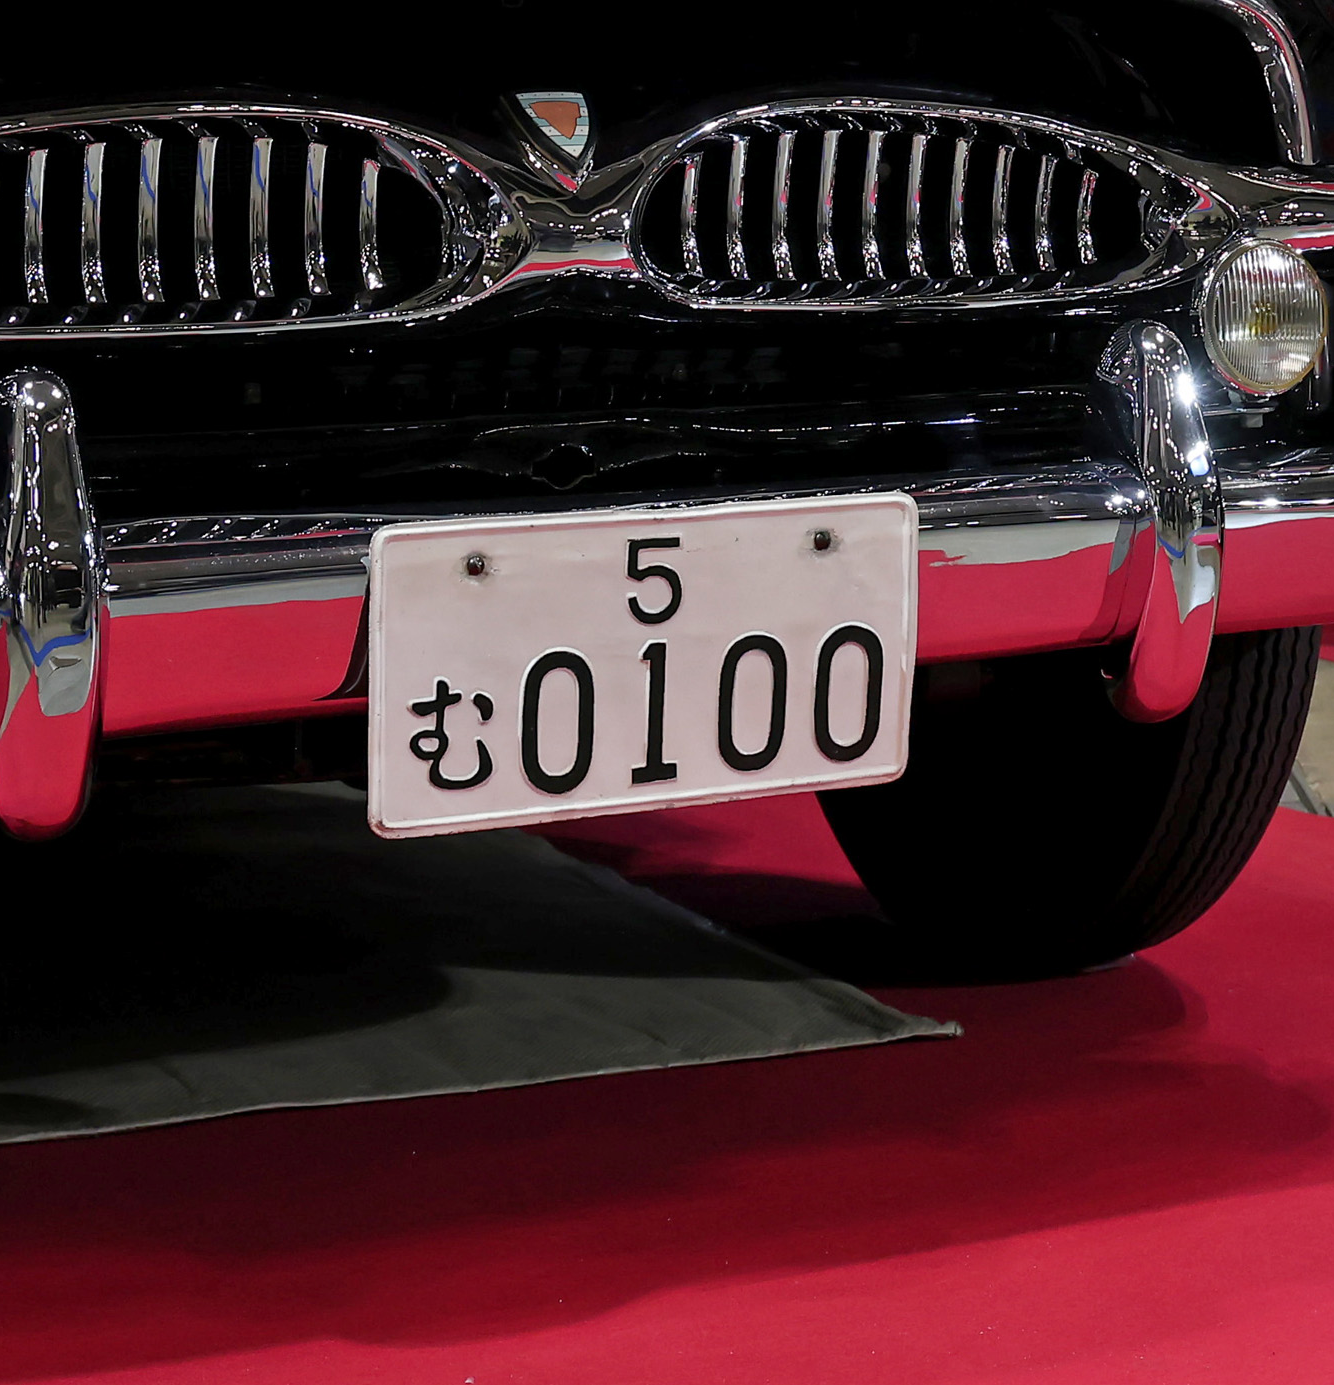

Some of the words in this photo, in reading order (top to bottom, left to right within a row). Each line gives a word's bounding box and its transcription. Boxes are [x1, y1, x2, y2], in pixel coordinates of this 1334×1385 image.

[626, 535, 683, 625] 5
[409, 678, 494, 790] む
[520, 623, 885, 796] 0100
